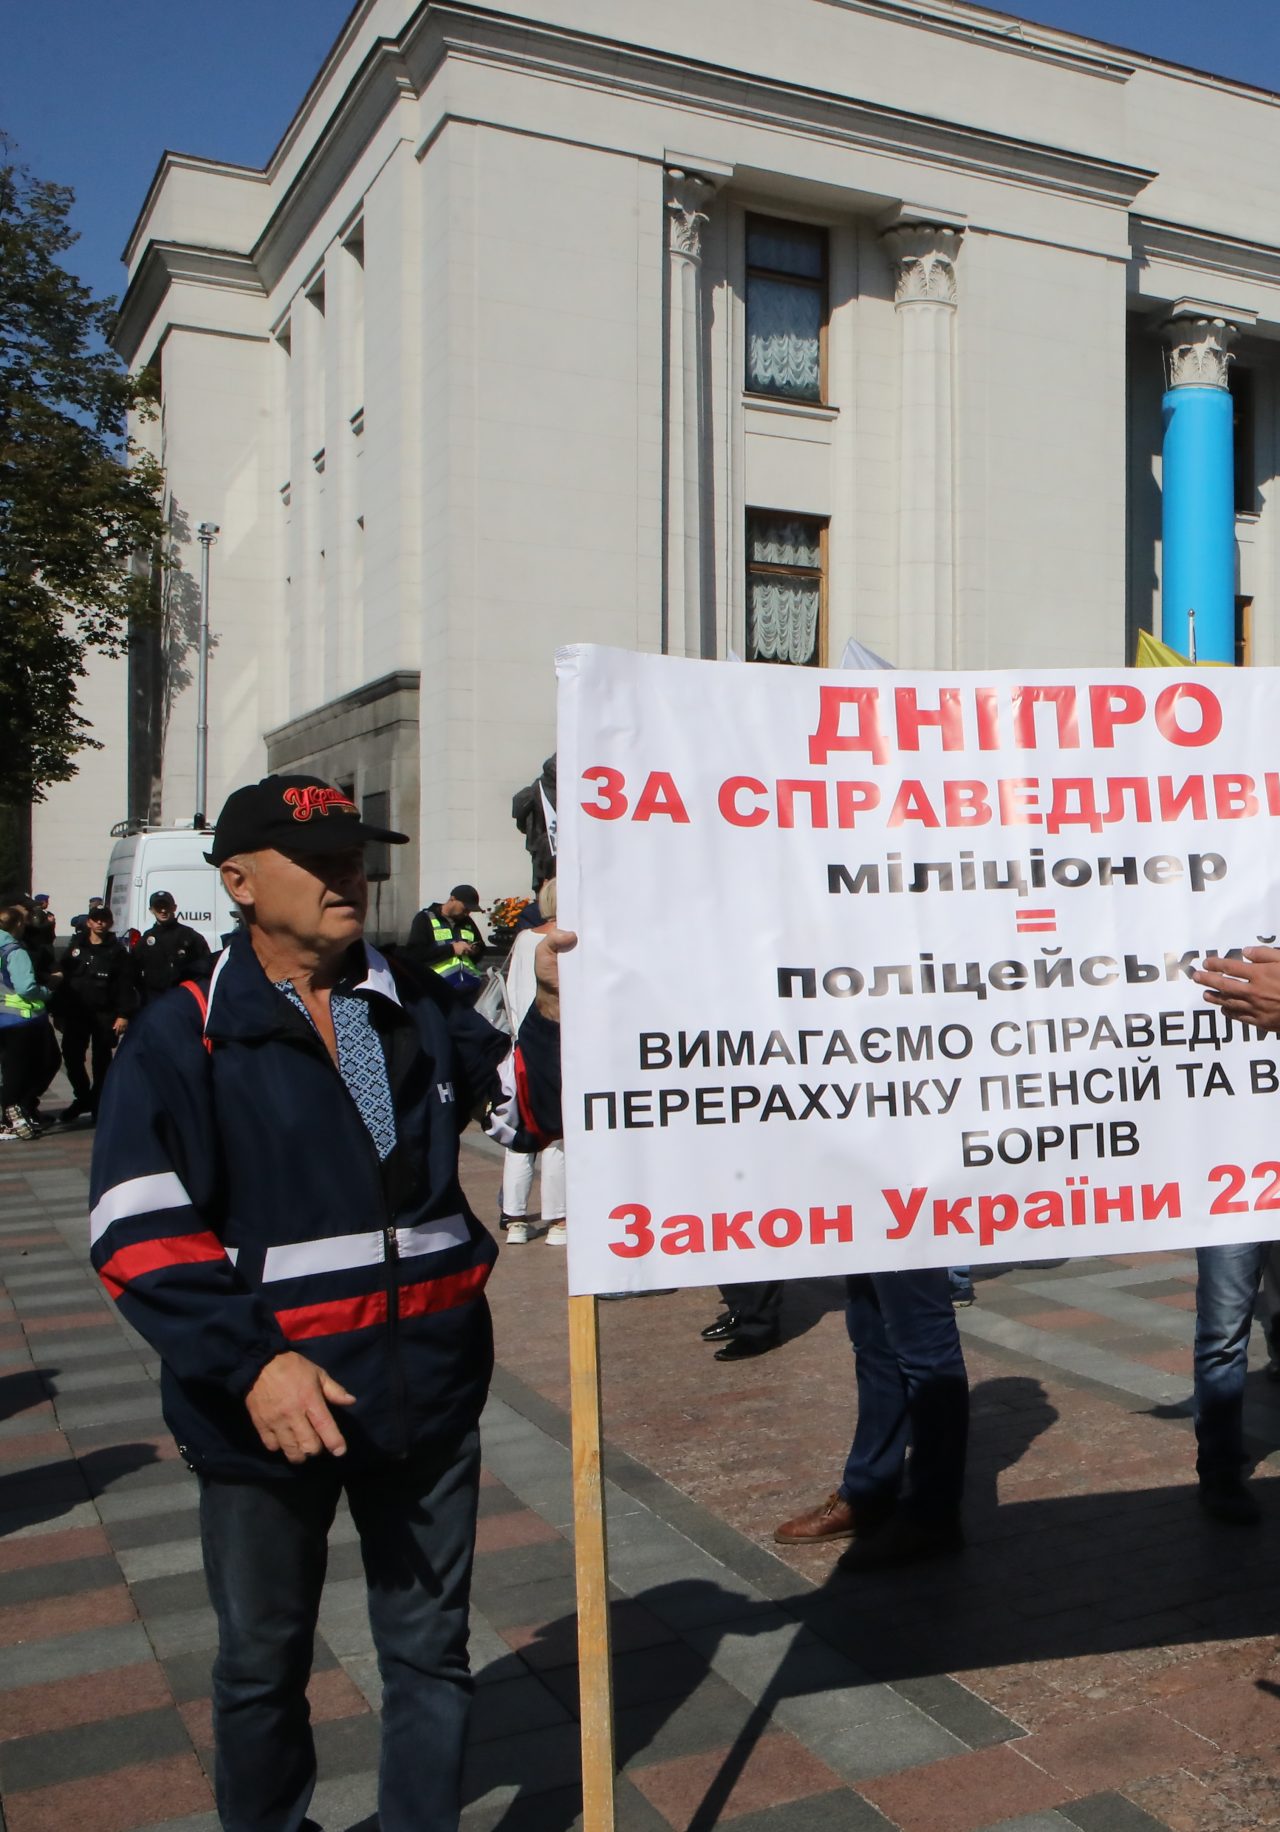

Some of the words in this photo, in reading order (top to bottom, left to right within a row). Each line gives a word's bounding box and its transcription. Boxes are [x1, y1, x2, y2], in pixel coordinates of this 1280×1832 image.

[808, 682, 1223, 765] ДНІПРО
[581, 766, 690, 823] ЗА
[827, 849, 1228, 897] міліціонер
[177, 911, 212, 921] ЛІЦІЯ
[639, 1023, 974, 1071] ВИМАГАЄМО
[584, 1078, 963, 1132] ПЕРЕРАХУНКУ
[980, 1056, 1161, 1112] ПЕНСІЙ
[1175, 1062, 1234, 1098] ТА
[961, 1121, 1140, 1168] БОРГІВ
[607, 1203, 854, 1259] Закон
[881, 1175, 1182, 1247] України
